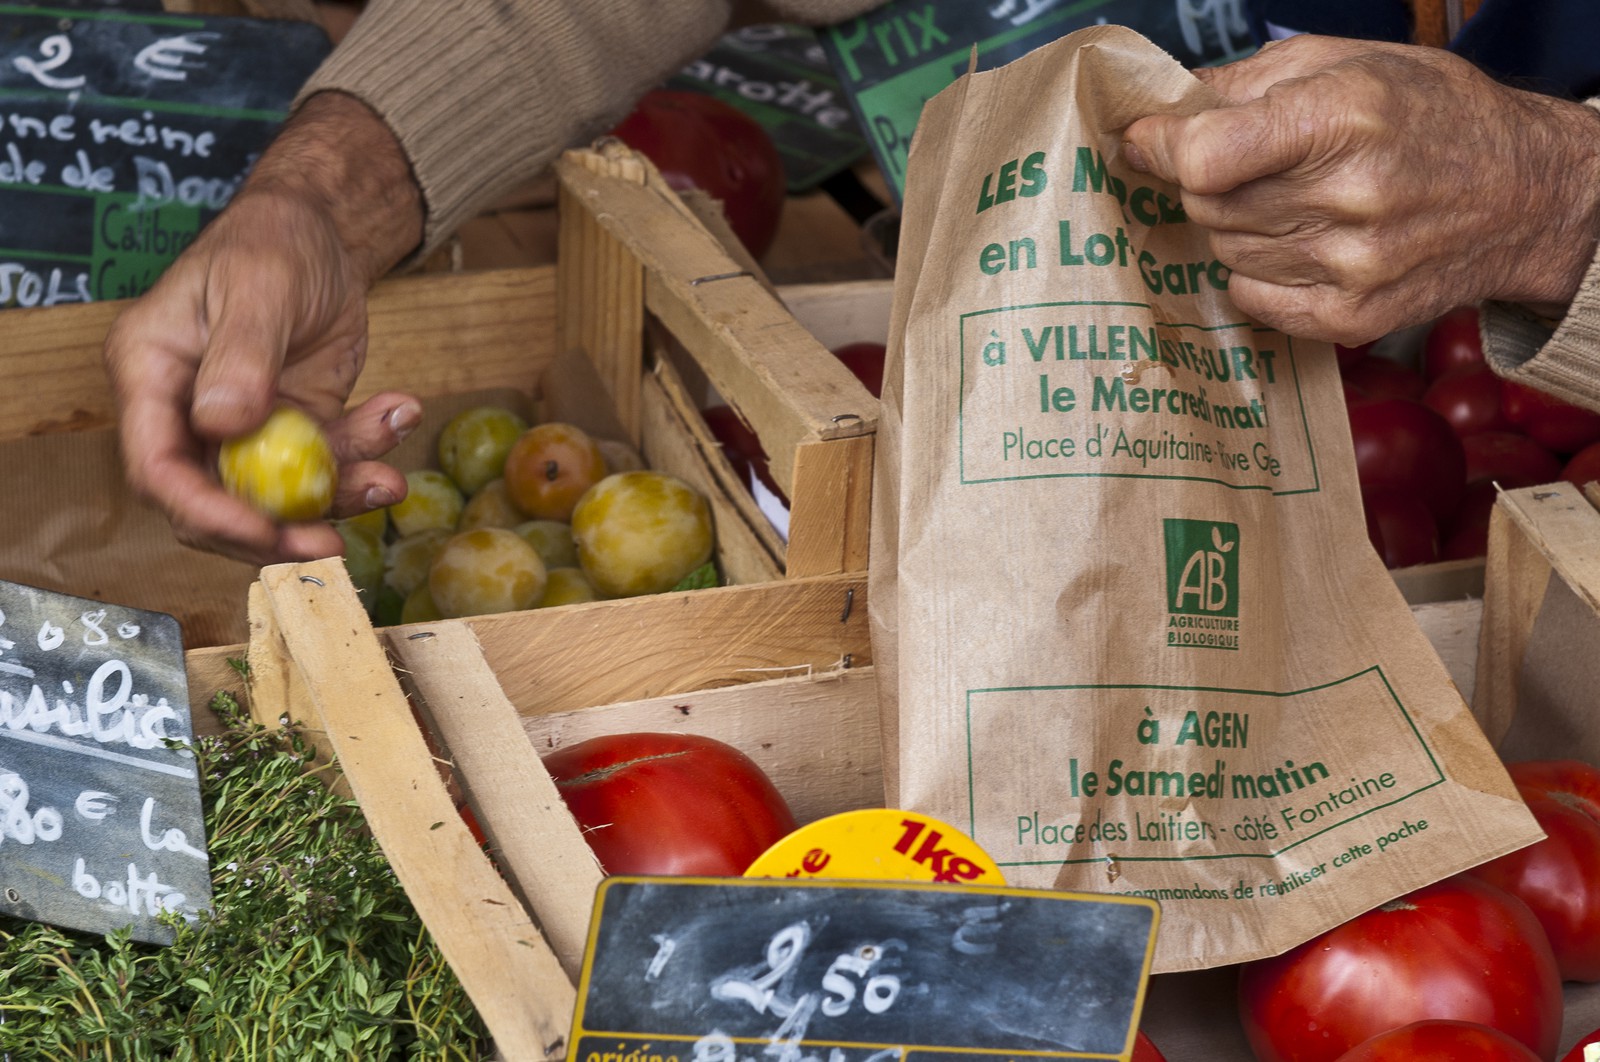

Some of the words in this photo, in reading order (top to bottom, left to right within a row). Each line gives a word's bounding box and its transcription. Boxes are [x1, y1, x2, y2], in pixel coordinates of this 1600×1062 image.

[831, 4, 950, 82] Prix
[89, 110, 216, 158] reine
[61, 149, 115, 194] de
[976, 151, 1047, 214] LES
[979, 236, 1037, 275] en
[982, 329, 1006, 367] à
[1040, 375, 1076, 413] le
[1091, 374, 1212, 424] Mercredi
[1003, 427, 1076, 462] Place
[1175, 550, 1229, 612] AB
[1167, 632, 1240, 647] BIOLOGIQUE
[1168, 616, 1240, 632] AGRICULTURE
[1137, 706, 1159, 745] à
[1176, 710, 1249, 749] AGEN
[1069, 758, 1099, 798] le
[1105, 759, 1226, 799] Samedi
[1232, 760, 1330, 799] matin
[1017, 811, 1084, 845] Place
[1088, 808, 1128, 842] des
[1136, 811, 1217, 842] Laitiers
[1233, 815, 1279, 842] côté
[1280, 772, 1396, 832] Fontaine
[893, 819, 987, 880] 1kg
[1233, 880, 1254, 900] de
[1259, 862, 1327, 896] réutiliser
[1332, 844, 1373, 868] cette
[1375, 819, 1429, 852] poche
